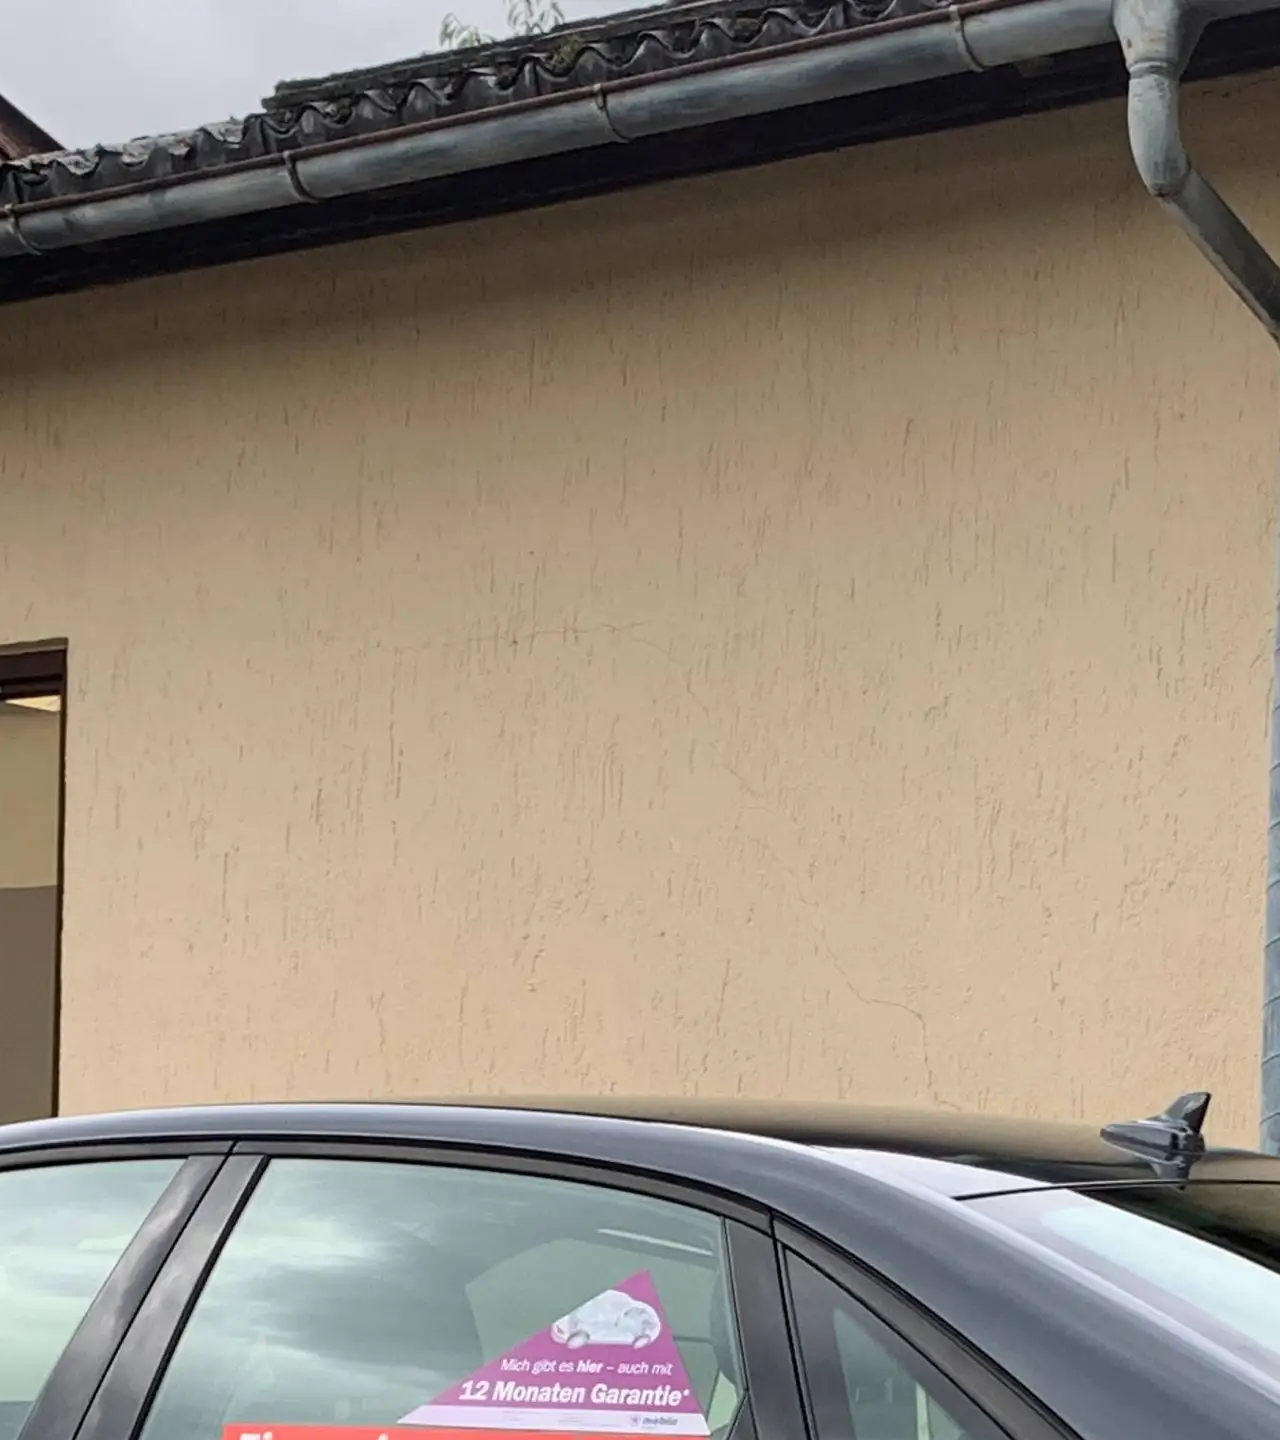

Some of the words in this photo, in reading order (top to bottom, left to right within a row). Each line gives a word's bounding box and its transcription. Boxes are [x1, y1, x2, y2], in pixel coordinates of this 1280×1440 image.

[500, 1358, 530, 1371] Mich
[531, 1359, 557, 1375] gibt
[558, 1362, 574, 1373] es
[576, 1361, 603, 1374] hier
[618, 1362, 648, 1375] auch
[651, 1363, 673, 1376] mit
[458, 1380, 489, 1401] 12
[491, 1381, 587, 1404] Monaten
